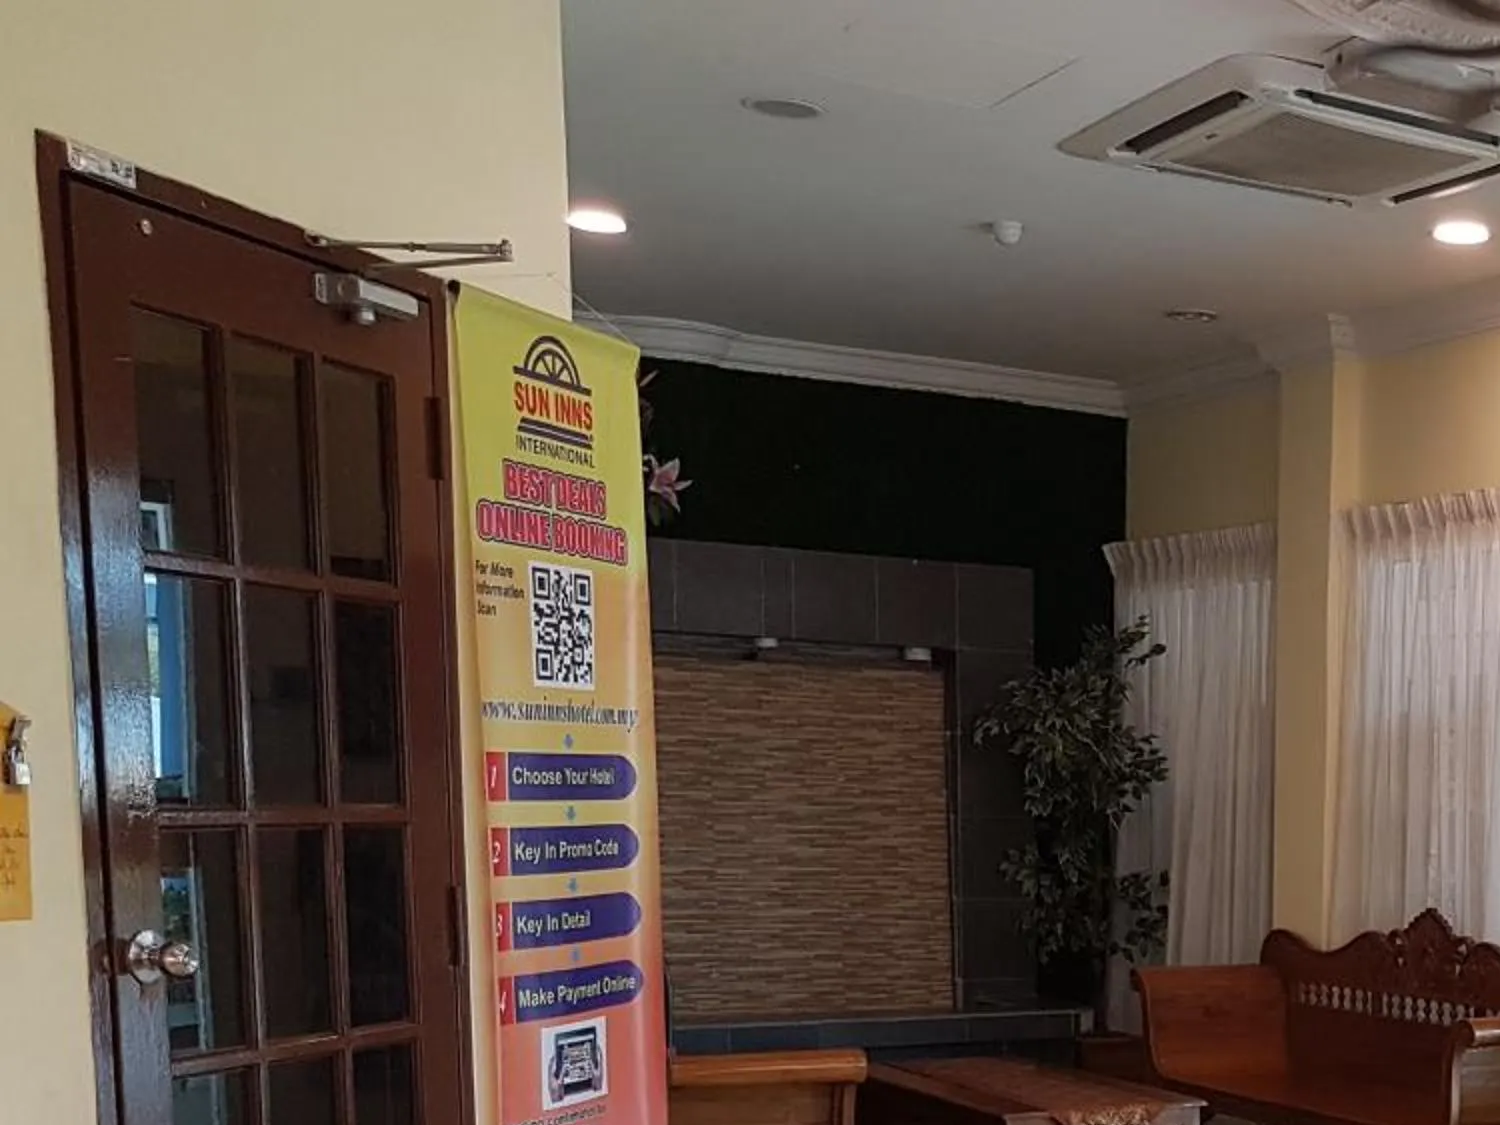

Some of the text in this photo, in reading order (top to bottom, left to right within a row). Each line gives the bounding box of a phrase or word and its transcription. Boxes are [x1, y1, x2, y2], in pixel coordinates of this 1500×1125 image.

[513, 381, 593, 432] SUN INNS
[515, 434, 595, 468] INTERNATIONAL
[503, 459, 607, 520] BEST DEALS
[476, 498, 552, 550] ONLINE
[511, 767, 562, 786] Choose
[564, 767, 589, 786] Your
[589, 768, 615, 785] Hotel
[514, 843, 541, 865] Key
[545, 842, 557, 859] In
[559, 840, 594, 859] Promo
[594, 838, 620, 856] Code
[516, 916, 543, 937] Key
[546, 914, 559, 932] In
[561, 910, 591, 930] Detail
[518, 988, 555, 1009] Make
[557, 981, 602, 1005] Payment
[602, 975, 637, 994] Online
